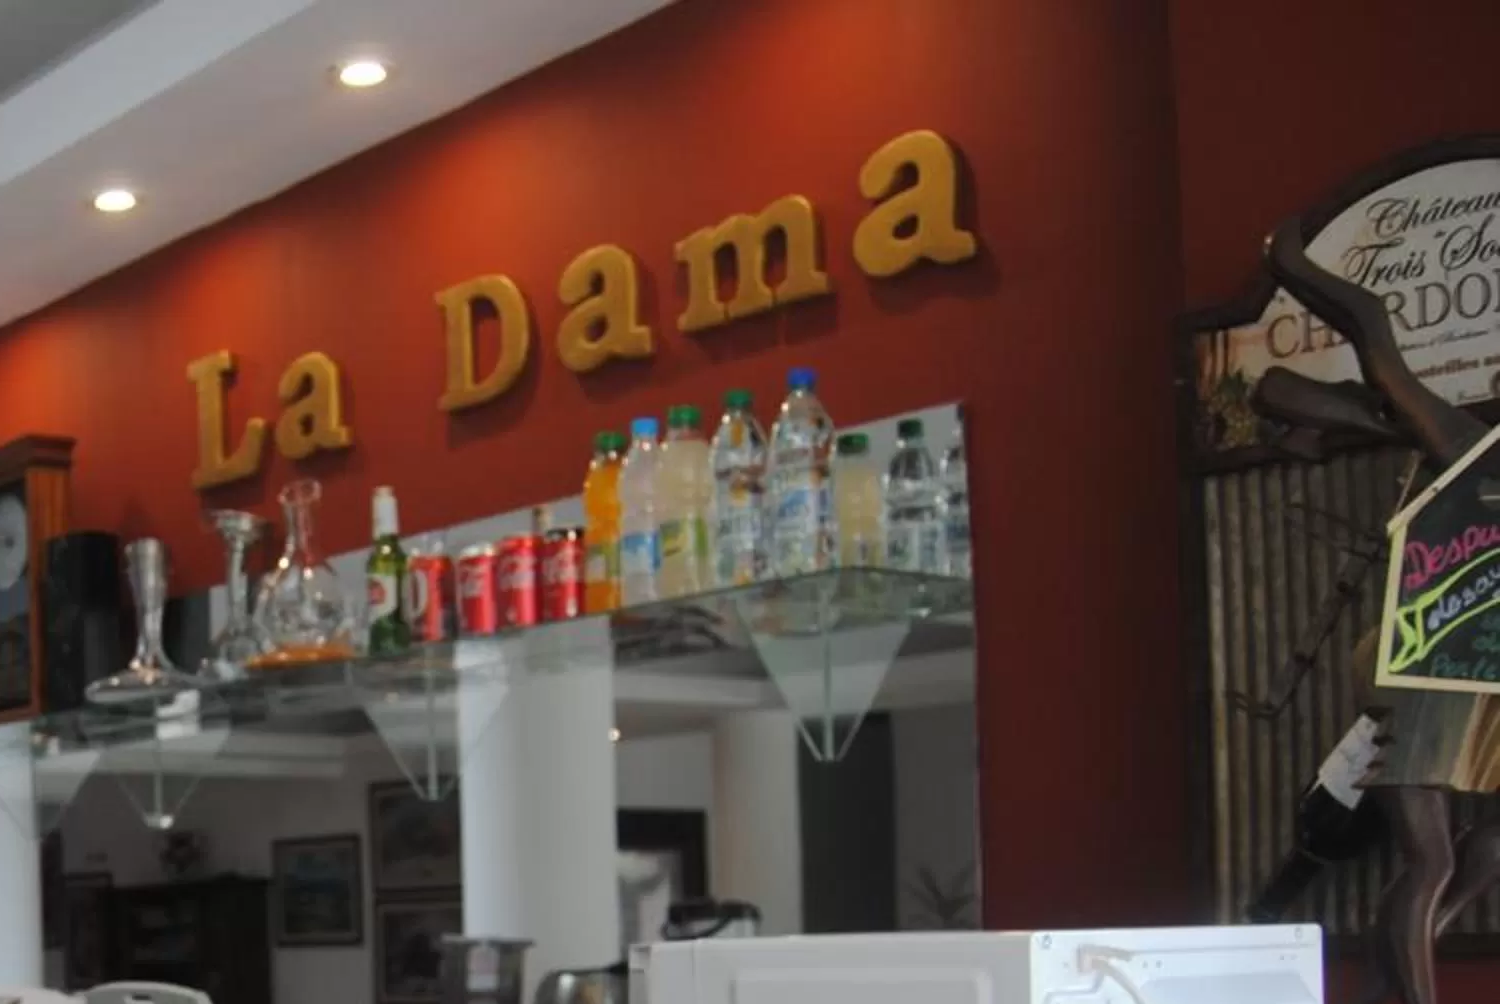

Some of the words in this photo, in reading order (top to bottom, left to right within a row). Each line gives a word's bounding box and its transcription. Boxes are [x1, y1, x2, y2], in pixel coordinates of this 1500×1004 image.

[186, 349, 353, 489] La
[434, 129, 977, 413] Dama
[1341, 237, 1427, 288] Trois
